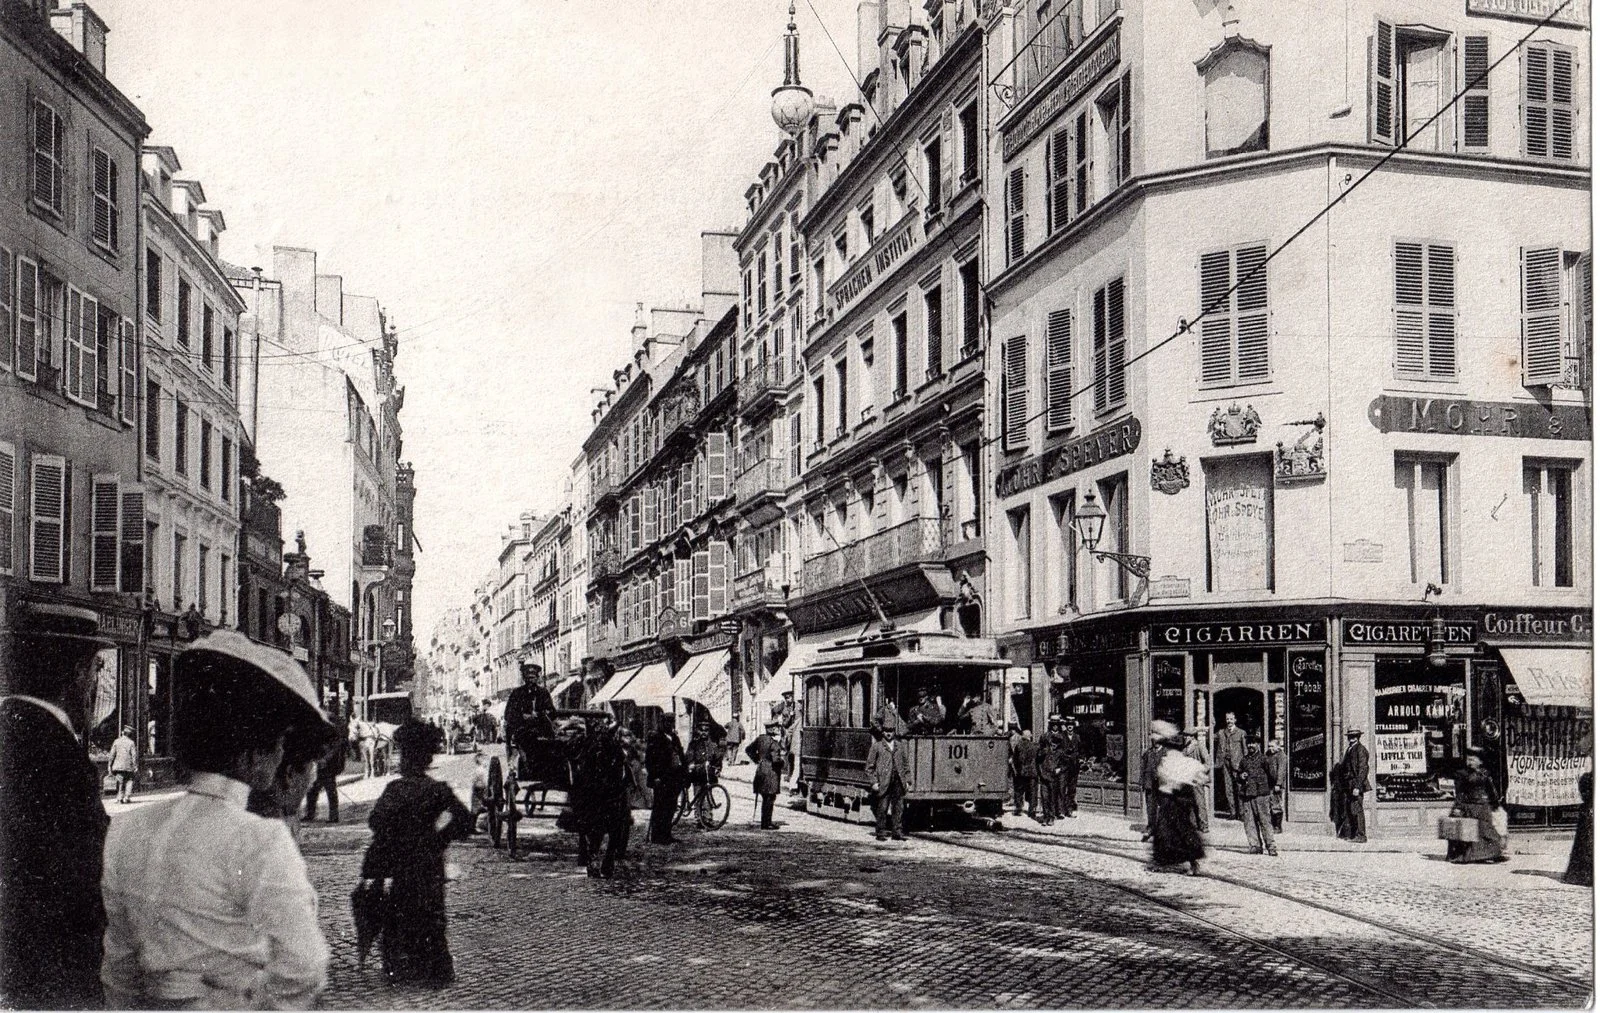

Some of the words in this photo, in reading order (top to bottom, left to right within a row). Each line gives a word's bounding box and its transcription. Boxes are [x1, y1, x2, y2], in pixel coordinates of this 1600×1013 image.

[835, 264, 872, 311] SPRACHEN
[875, 225, 917, 275] INSTITUT.
[1408, 399, 1523, 434] MOHR
[1548, 415, 1562, 435] &
[1061, 424, 1133, 472] SPEYER
[1163, 623, 1312, 643] CIGARREN
[1349, 624, 1473, 642] CIGARETEN
[1484, 613, 1567, 635] Coiffeur
[1387, 704, 1421, 716] ARNOLD
[949, 745, 968, 759] 101
[1380, 751, 1405, 761] LITTLE
